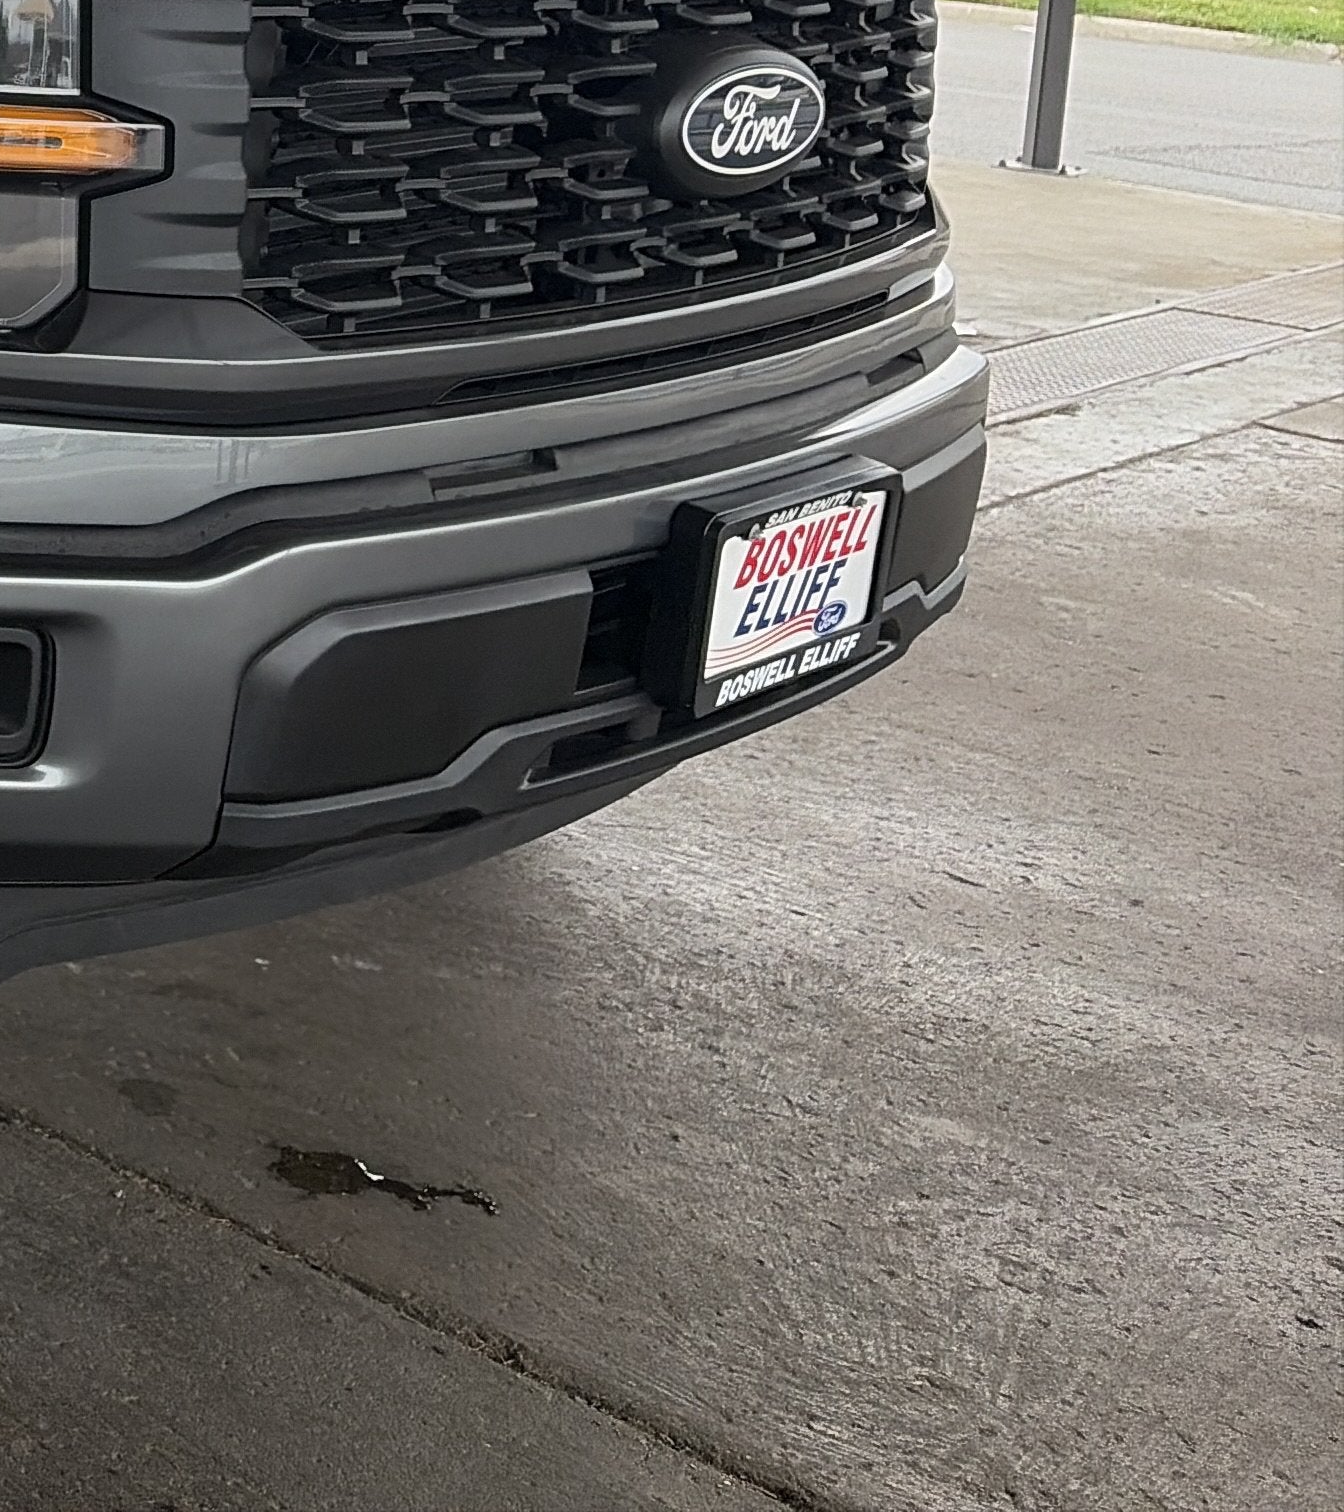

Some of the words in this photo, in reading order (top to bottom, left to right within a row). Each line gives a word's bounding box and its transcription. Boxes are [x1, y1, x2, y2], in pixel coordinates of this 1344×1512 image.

[712, 85, 800, 159] Ford
[733, 504, 878, 590] BOSWELL
[764, 507, 799, 529] SAN
[798, 490, 853, 519] BENITO
[733, 558, 848, 638] ELLIFF
[715, 655, 796, 708] BOSWELL
[798, 633, 861, 669] ELLIFF
